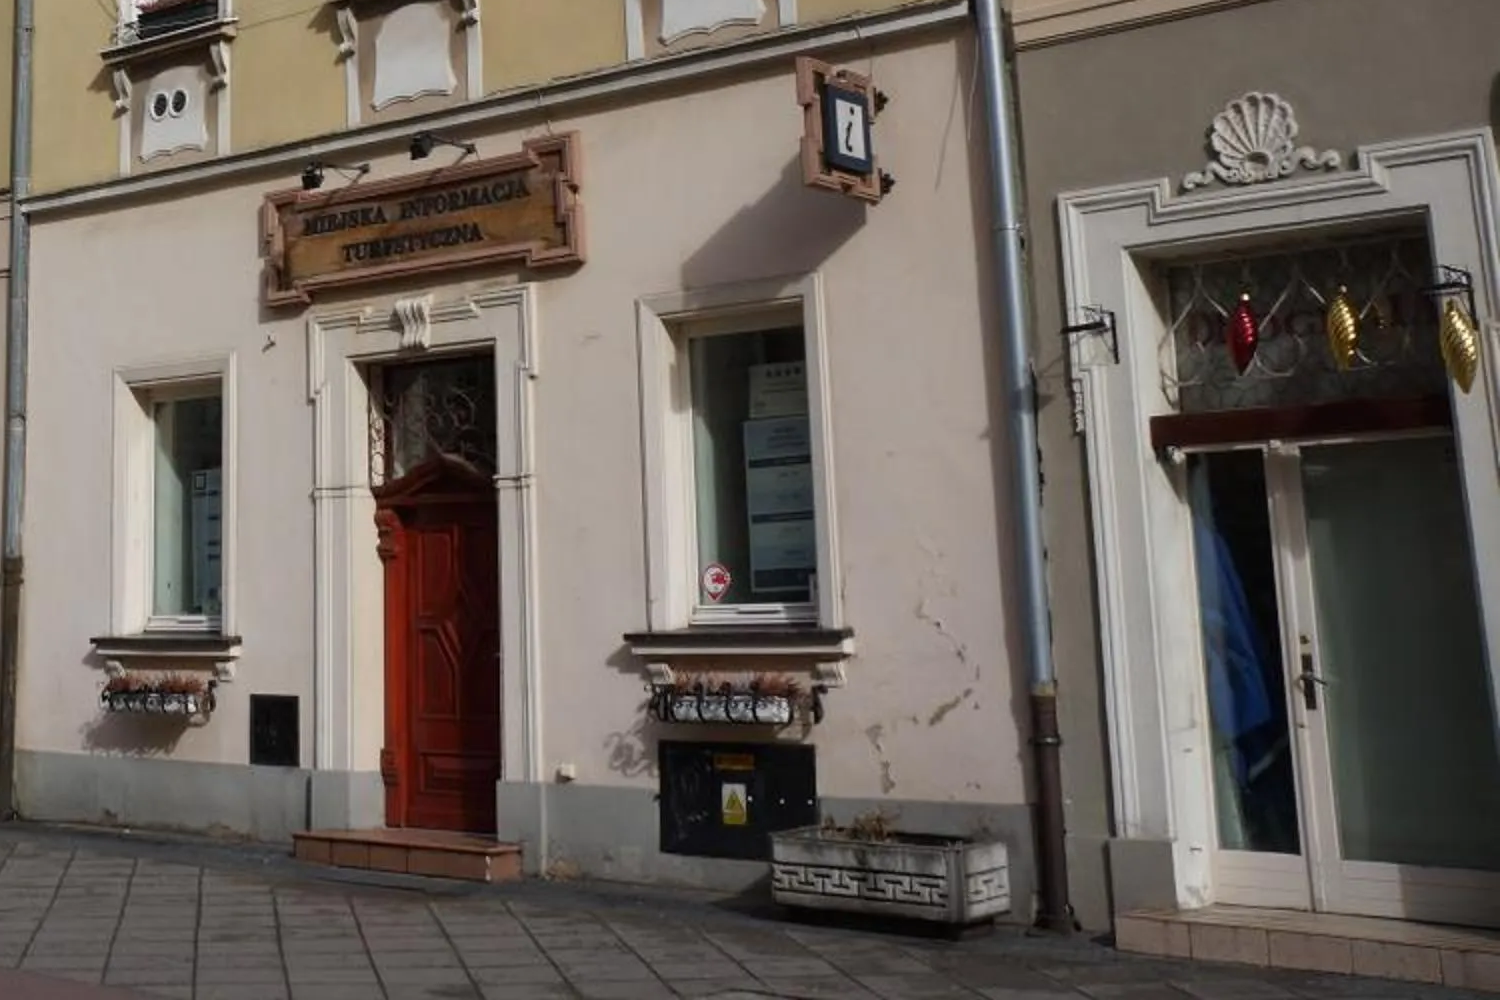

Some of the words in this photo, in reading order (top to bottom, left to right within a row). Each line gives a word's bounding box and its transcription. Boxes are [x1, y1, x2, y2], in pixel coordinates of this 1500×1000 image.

[302, 206, 387, 236] MIEJSKA
[400, 179, 531, 221] INFORMACJA
[341, 223, 483, 262] TURYSTYCZNA
